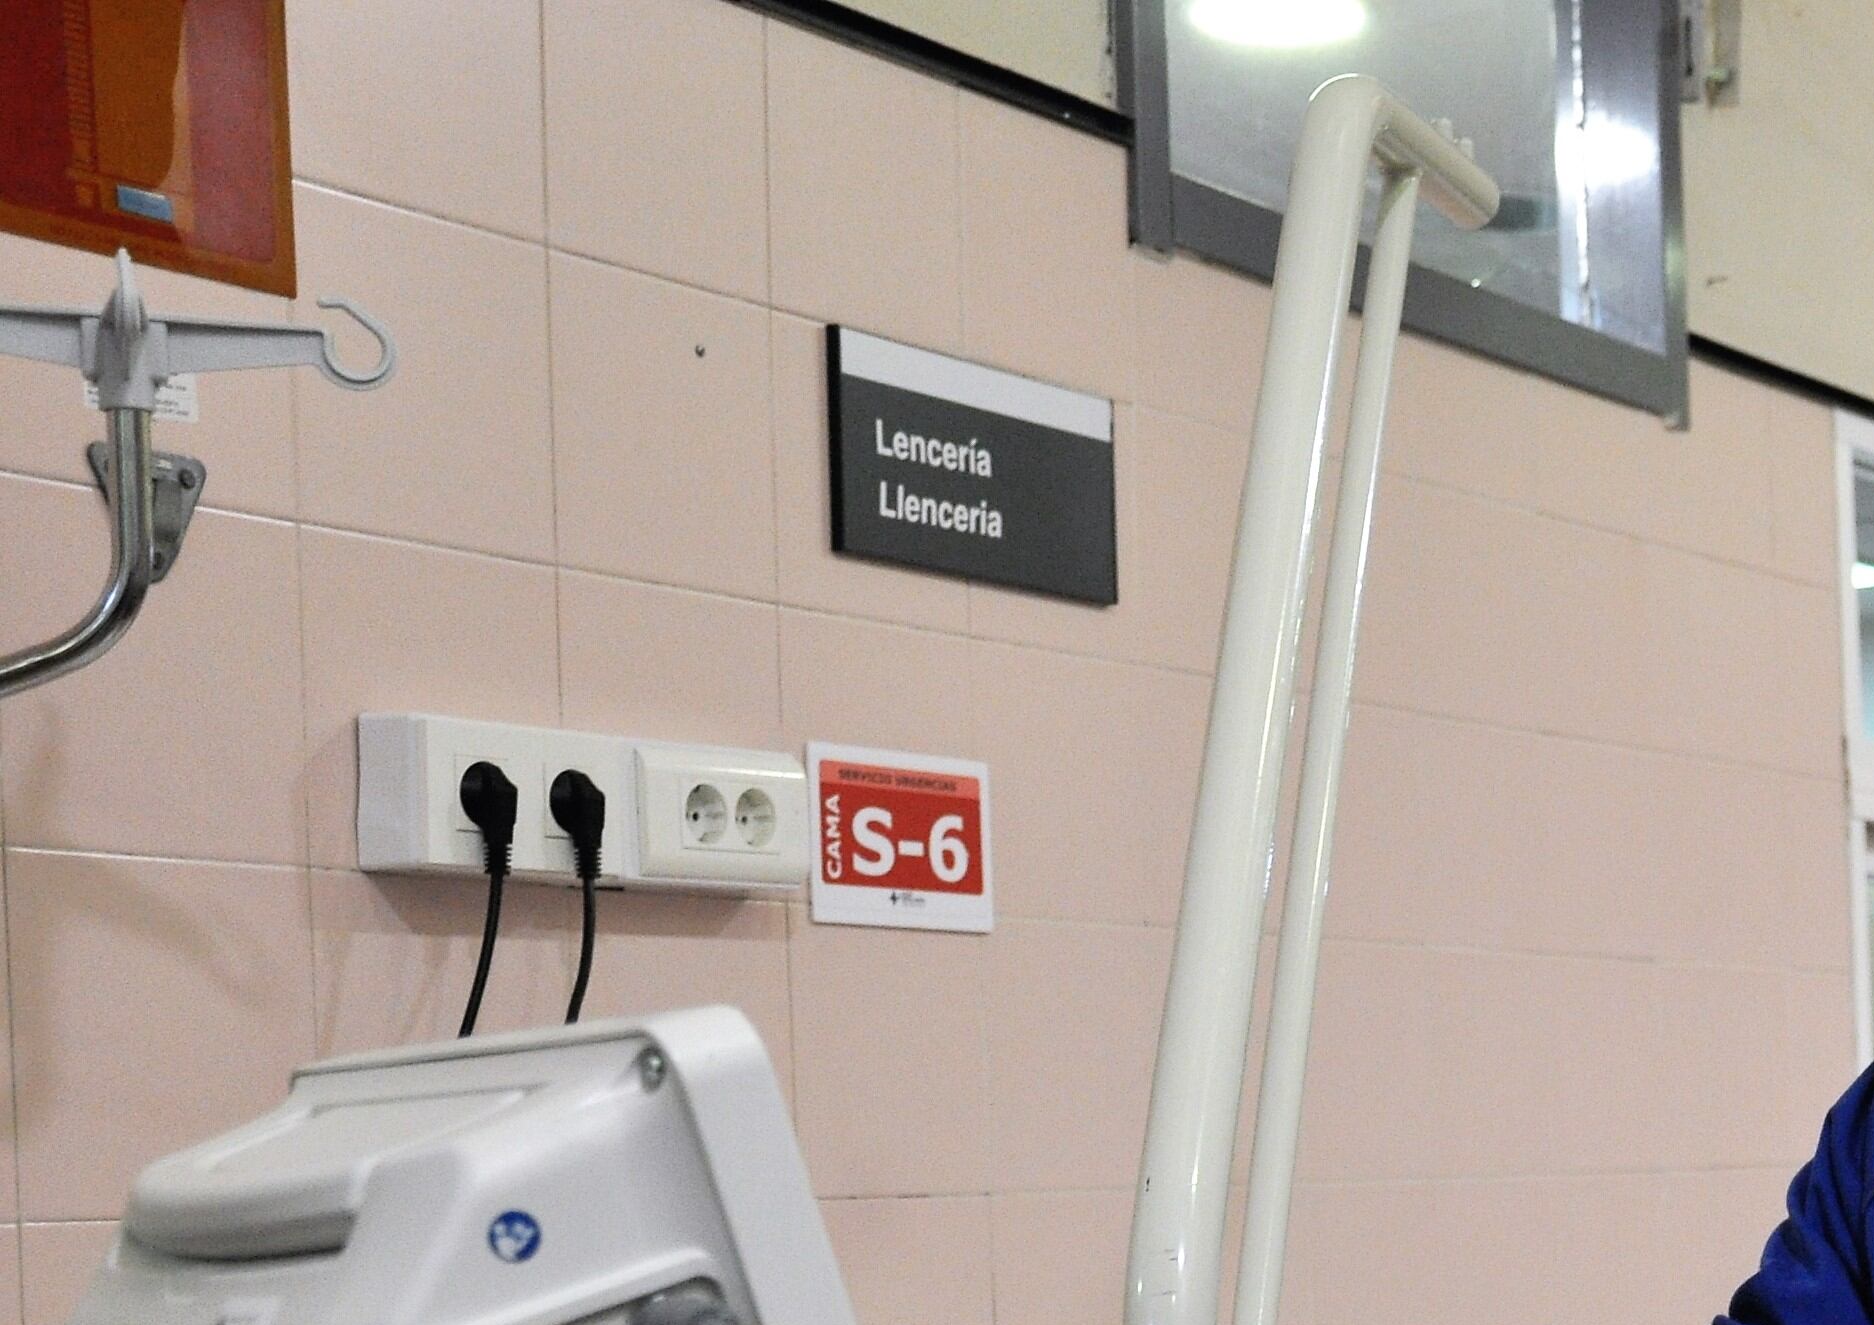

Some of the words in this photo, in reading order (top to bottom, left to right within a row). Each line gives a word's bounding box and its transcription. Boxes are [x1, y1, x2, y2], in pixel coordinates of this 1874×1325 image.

[875, 418, 992, 478] Lencería
[880, 481, 1002, 538] Llenceria
[825, 794, 843, 879] CAMA
[852, 806, 969, 884] S-6
